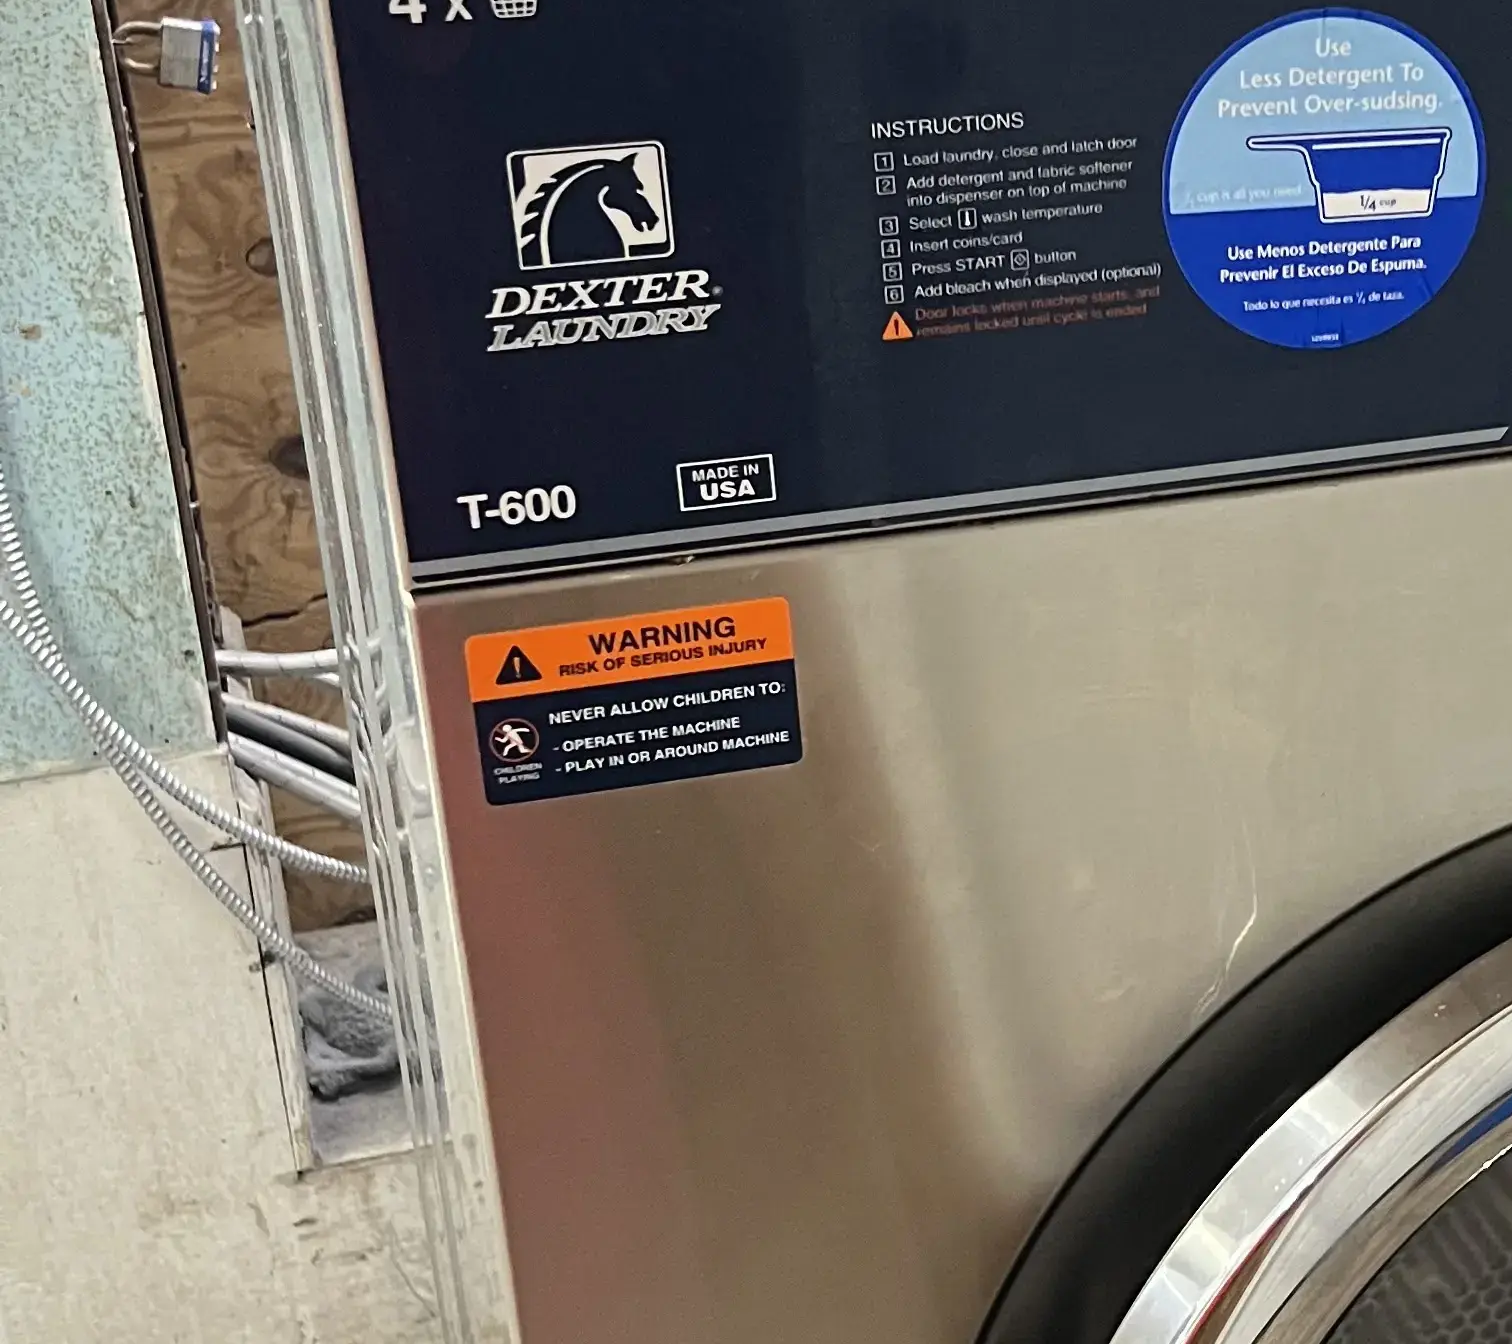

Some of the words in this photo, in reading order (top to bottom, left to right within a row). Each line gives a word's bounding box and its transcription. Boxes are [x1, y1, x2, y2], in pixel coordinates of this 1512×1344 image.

[1315, 38, 1351, 57] Use
[1240, 71, 1282, 89] Less
[1289, 65, 1393, 91] Detergent
[1400, 62, 1423, 81] To
[1218, 99, 1297, 118] Prevent
[1304, 91, 1443, 116] Over-sudsing.
[870, 112, 1024, 139] INSTRUCTIONS
[903, 153, 938, 167] Load
[1002, 146, 1038, 159] close
[1042, 142, 1068, 155] and
[1071, 139, 1104, 153] latch
[1107, 137, 1137, 149] door
[907, 175, 934, 189] Add
[940, 170, 1004, 189] detergent
[1008, 168, 1033, 181] and
[1037, 164, 1074, 179] fabric
[1078, 160, 1133, 175] softener
[907, 194, 932, 207] into
[936, 188, 1002, 204] dispenser
[1008, 188, 1025, 198] on
[1028, 184, 1050, 197] top
[1053, 181, 1066, 194] of
[1071, 178, 1126, 192] machine
[909, 216, 952, 230] Select
[981, 209, 1017, 224] wash
[1021, 203, 1103, 221] temperature
[909, 239, 948, 253] Insert
[952, 232, 1023, 250] coins/card
[1227, 246, 1253, 261] Use
[1257, 242, 1305, 259] Menos
[1309, 238, 1388, 256] Detergente
[1391, 236, 1421, 250] Para
[912, 261, 951, 275] Press
[956, 255, 1005, 272] START
[1034, 250, 1076, 265] button
[1220, 266, 1278, 283] Prevenir
[1282, 265, 1295, 279] El
[1298, 261, 1344, 278] Exceso
[1348, 260, 1367, 274] De
[1371, 257, 1427, 274] Espuma.
[485, 269, 710, 319] DEXTER
[915, 284, 942, 299] Add
[945, 280, 991, 296] bleach
[995, 277, 1032, 290] when
[1034, 269, 1097, 287] displayed
[1101, 263, 1161, 282] (optional)
[486, 304, 721, 352] LAUNDRY
[692, 466, 736, 482] MADE
[740, 463, 759, 477] IN
[700, 478, 755, 501] USA
[457, 485, 577, 530] T-600
[589, 616, 736, 656] WARNING
[559, 660, 597, 677] RISK
[604, 657, 625, 671] OF
[631, 647, 704, 668] SERIOUS
[708, 638, 767, 657] INJURY
[549, 706, 606, 725] NEVER
[610, 697, 669, 717] ALLOW
[673, 685, 755, 707] CHILDREN
[758, 682, 786, 695] TO:
[562, 732, 635, 753] OPERATE
[639, 729, 668, 742] THE
[672, 717, 740, 737] MACHINE
[565, 758, 605, 773] PLAY
[609, 754, 624, 766] IN
[628, 751, 650, 764] OR
[654, 741, 719, 761] AROUND
[722, 730, 790, 750] MACHINE
